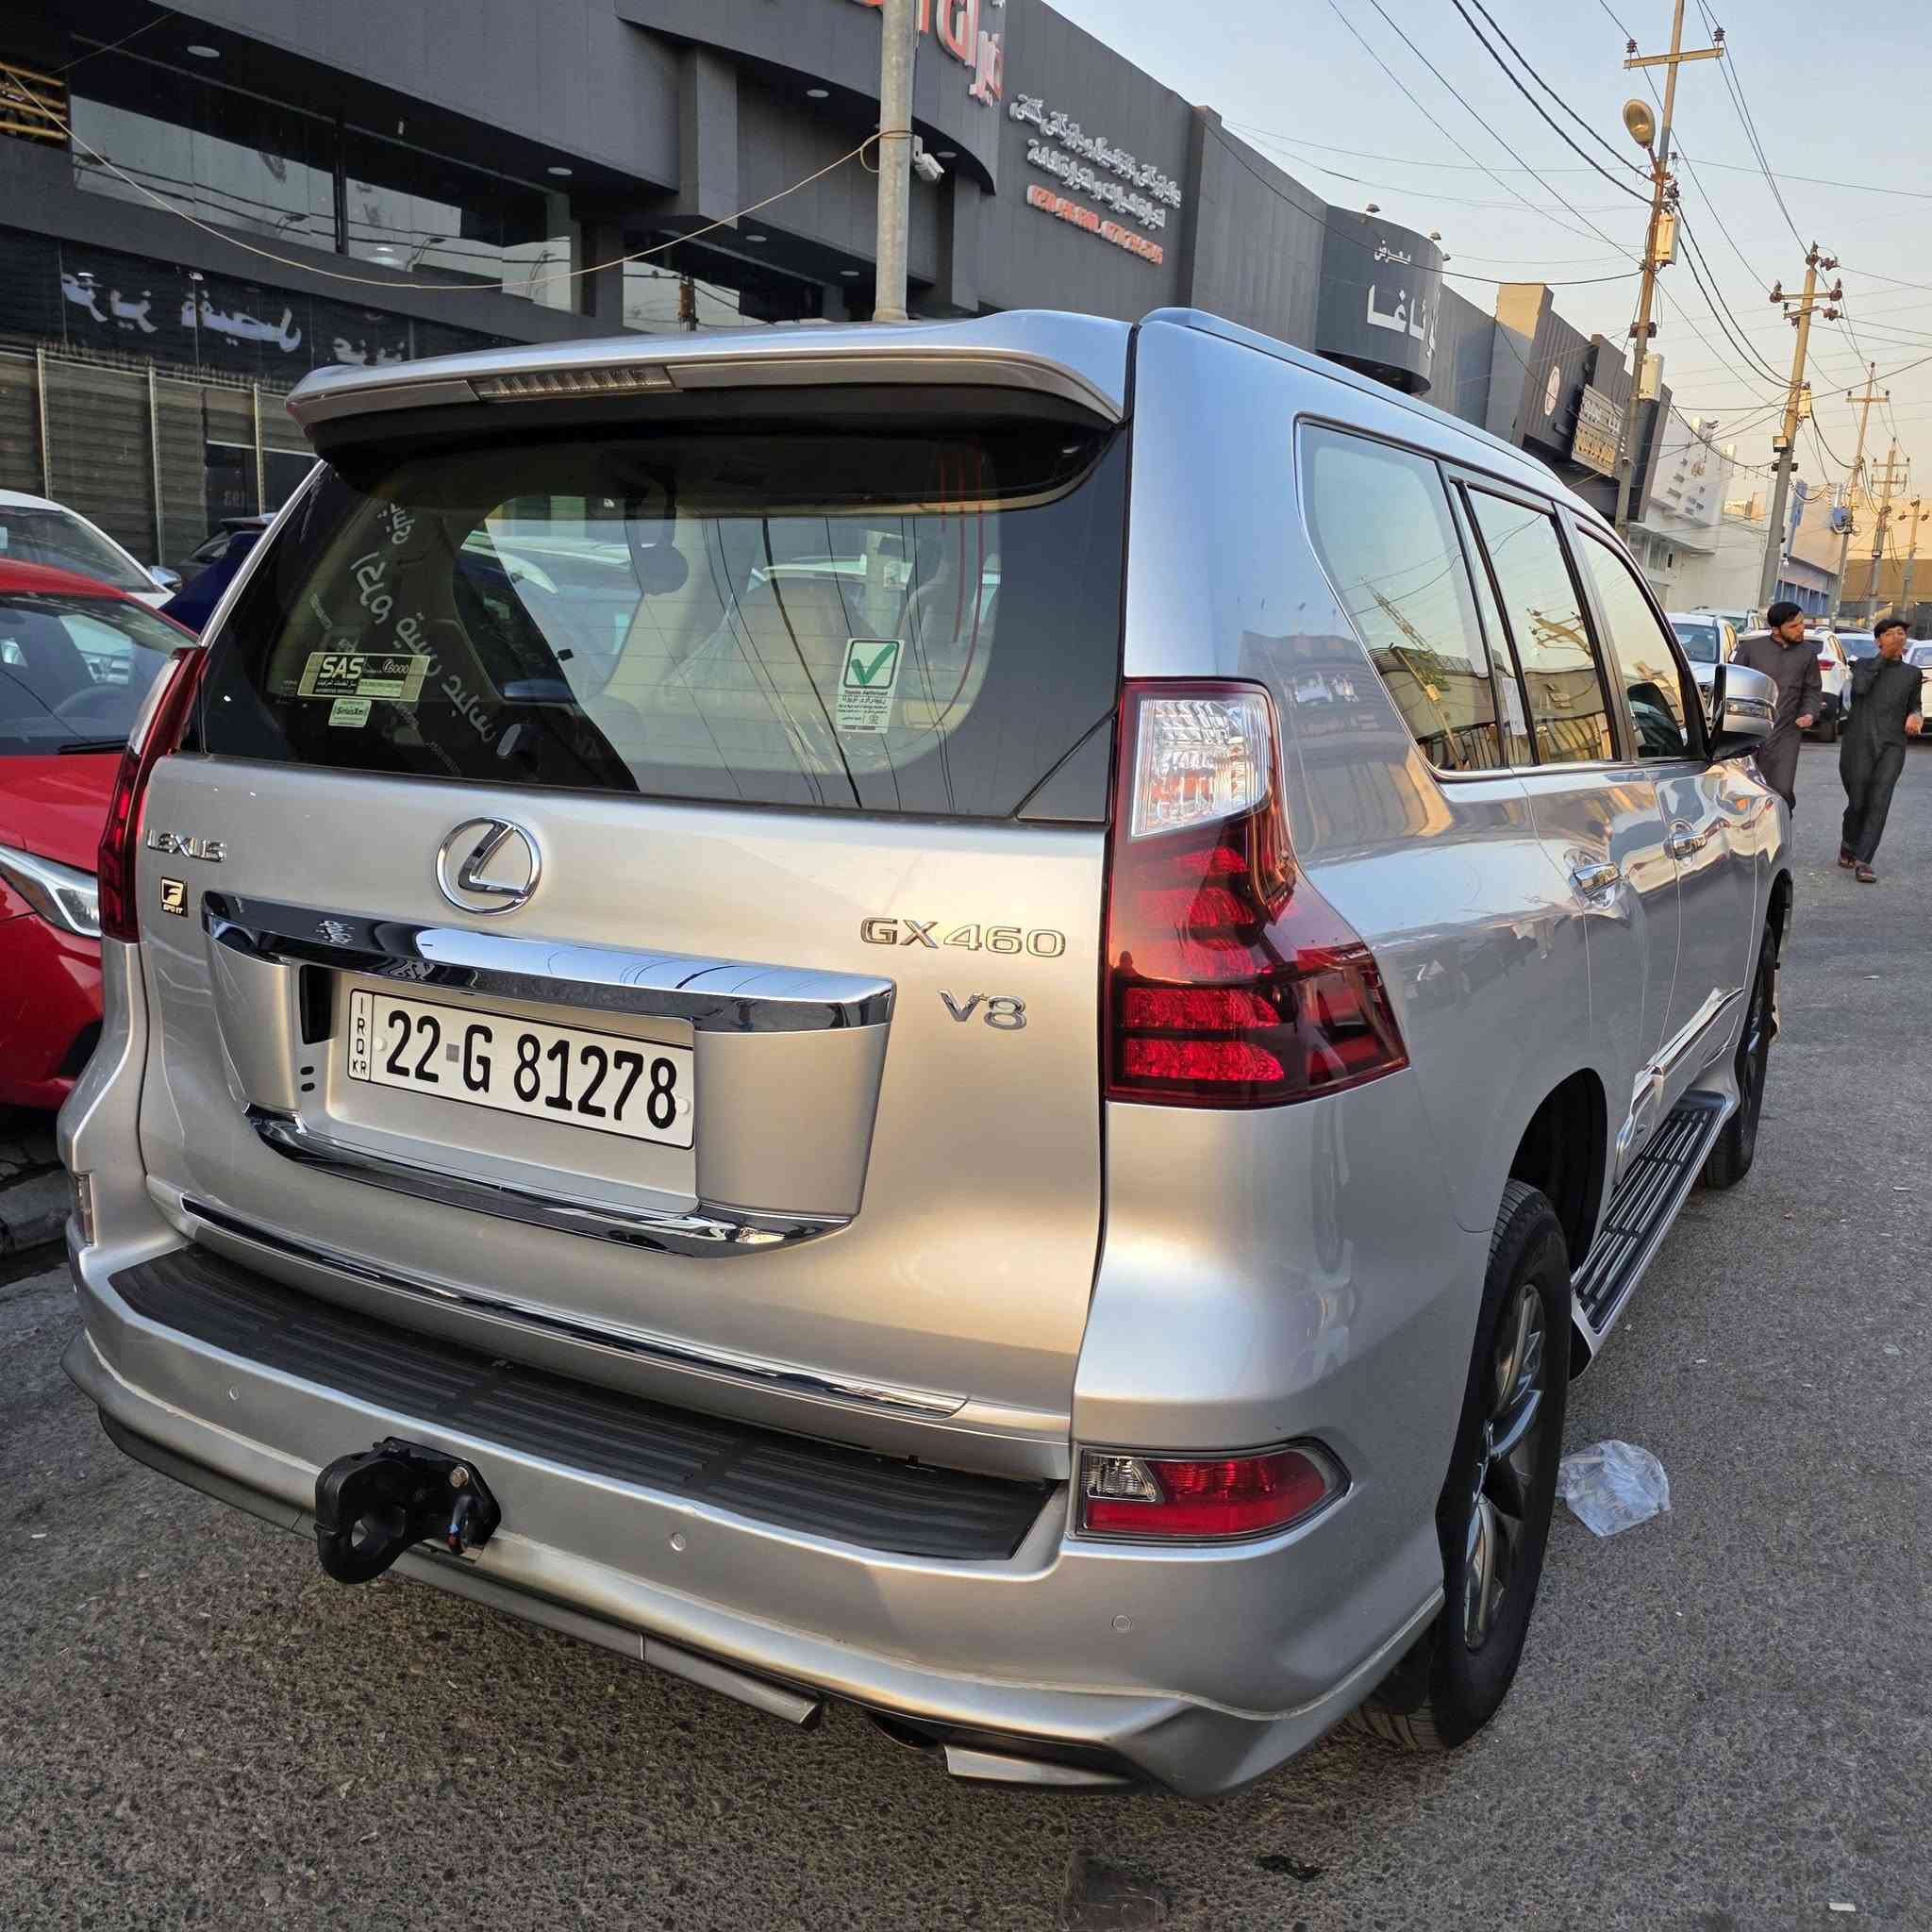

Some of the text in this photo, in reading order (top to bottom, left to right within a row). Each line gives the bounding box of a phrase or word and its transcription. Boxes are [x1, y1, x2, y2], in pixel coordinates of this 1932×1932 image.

[319, 656, 365, 679] SAS
[147, 829, 227, 862] LEXUS
[938, 990, 1027, 1031] V8
[352, 1058, 368, 1075] KR
[386, 1009, 677, 1129] 22 G 81278
